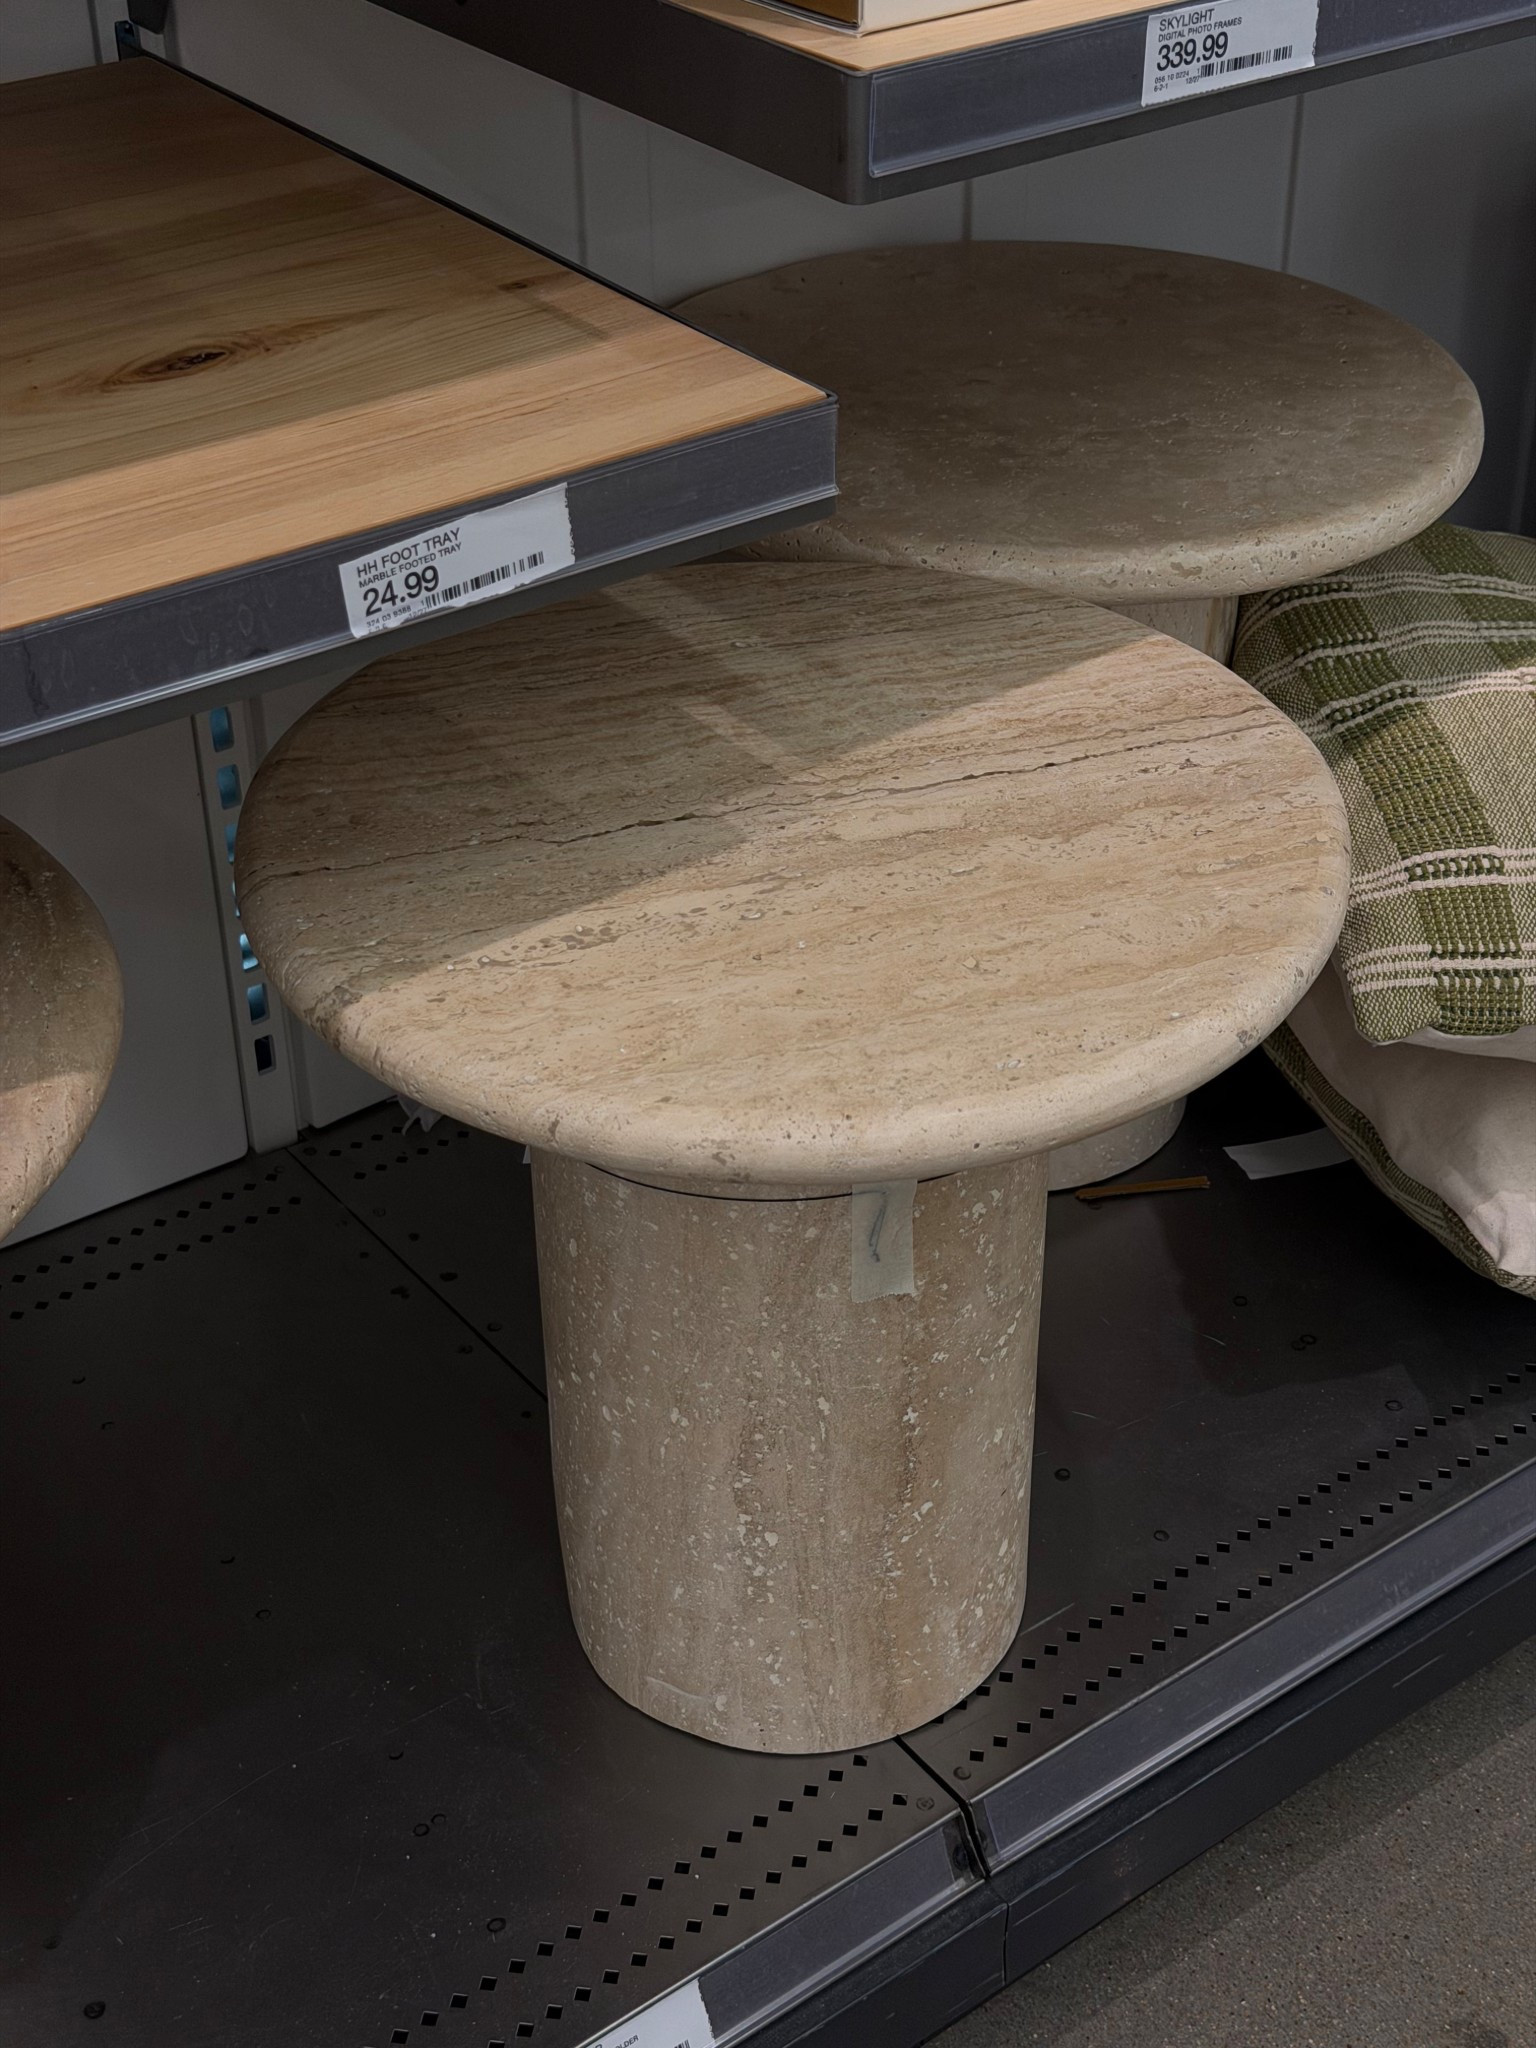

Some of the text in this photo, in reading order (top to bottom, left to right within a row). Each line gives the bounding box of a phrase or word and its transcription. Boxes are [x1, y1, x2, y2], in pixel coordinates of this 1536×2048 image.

[1158, 16, 1243, 43] DIGITAL PHOTO FRAMES
[1159, 8, 1215, 32] SKYLIGHT
[1156, 31, 1229, 72] 339.99
[356, 527, 460, 578] HH FOOT TRAY
[358, 541, 462, 589] MARBLE FOOTED TRAY
[363, 565, 440, 618] 24.99
